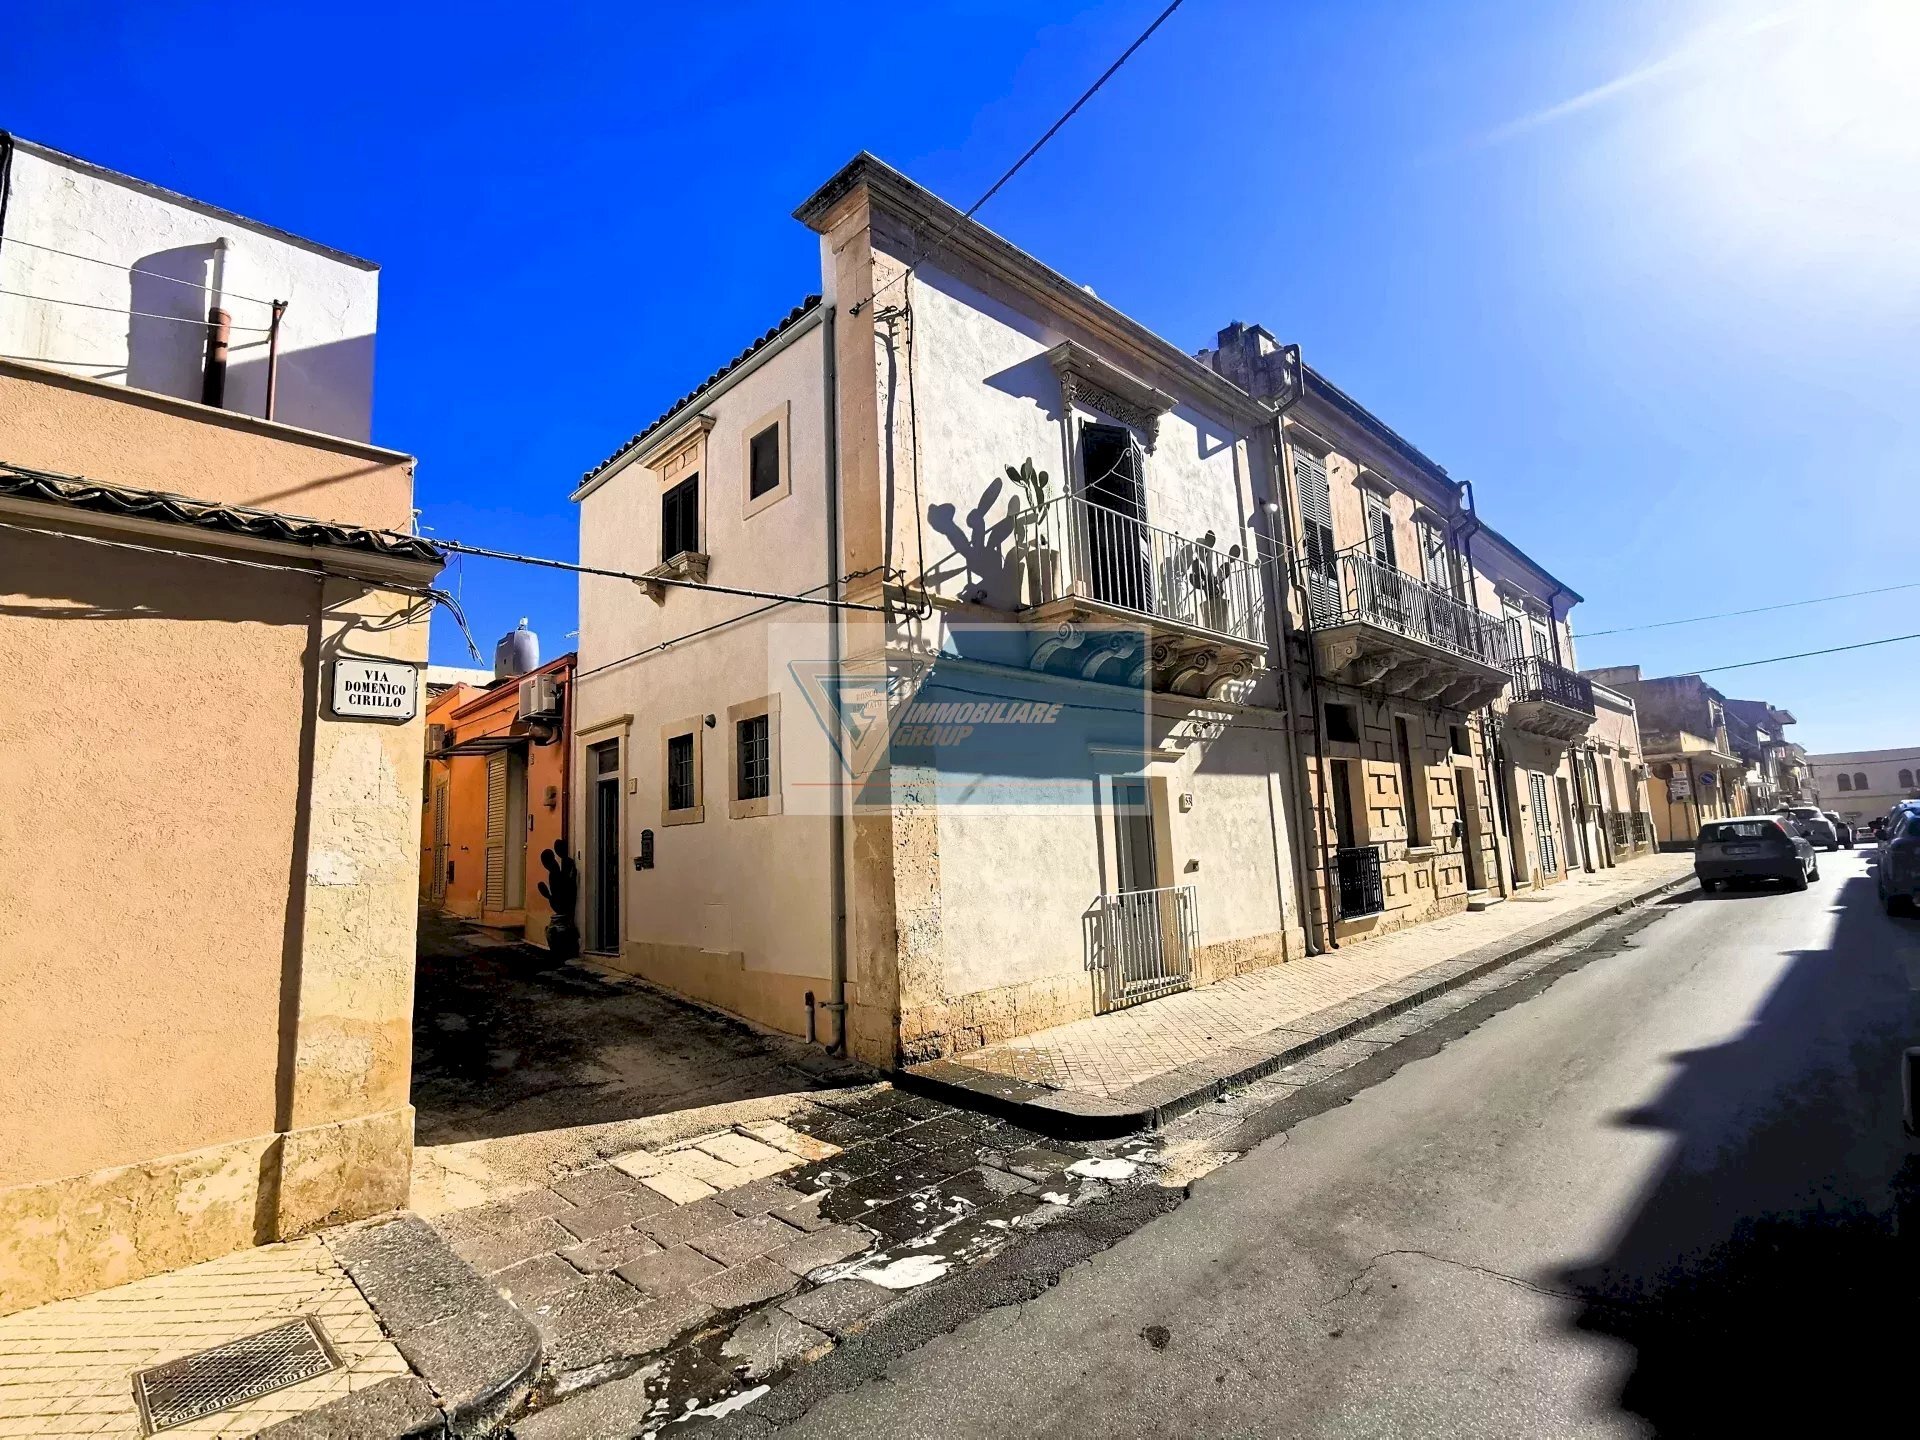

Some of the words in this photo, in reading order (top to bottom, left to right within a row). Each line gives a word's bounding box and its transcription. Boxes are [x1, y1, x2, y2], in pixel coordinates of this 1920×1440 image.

[365, 670, 389, 682] VIA
[345, 681, 406, 695] DOMENICO
[349, 694, 401, 707] CIRILLO
